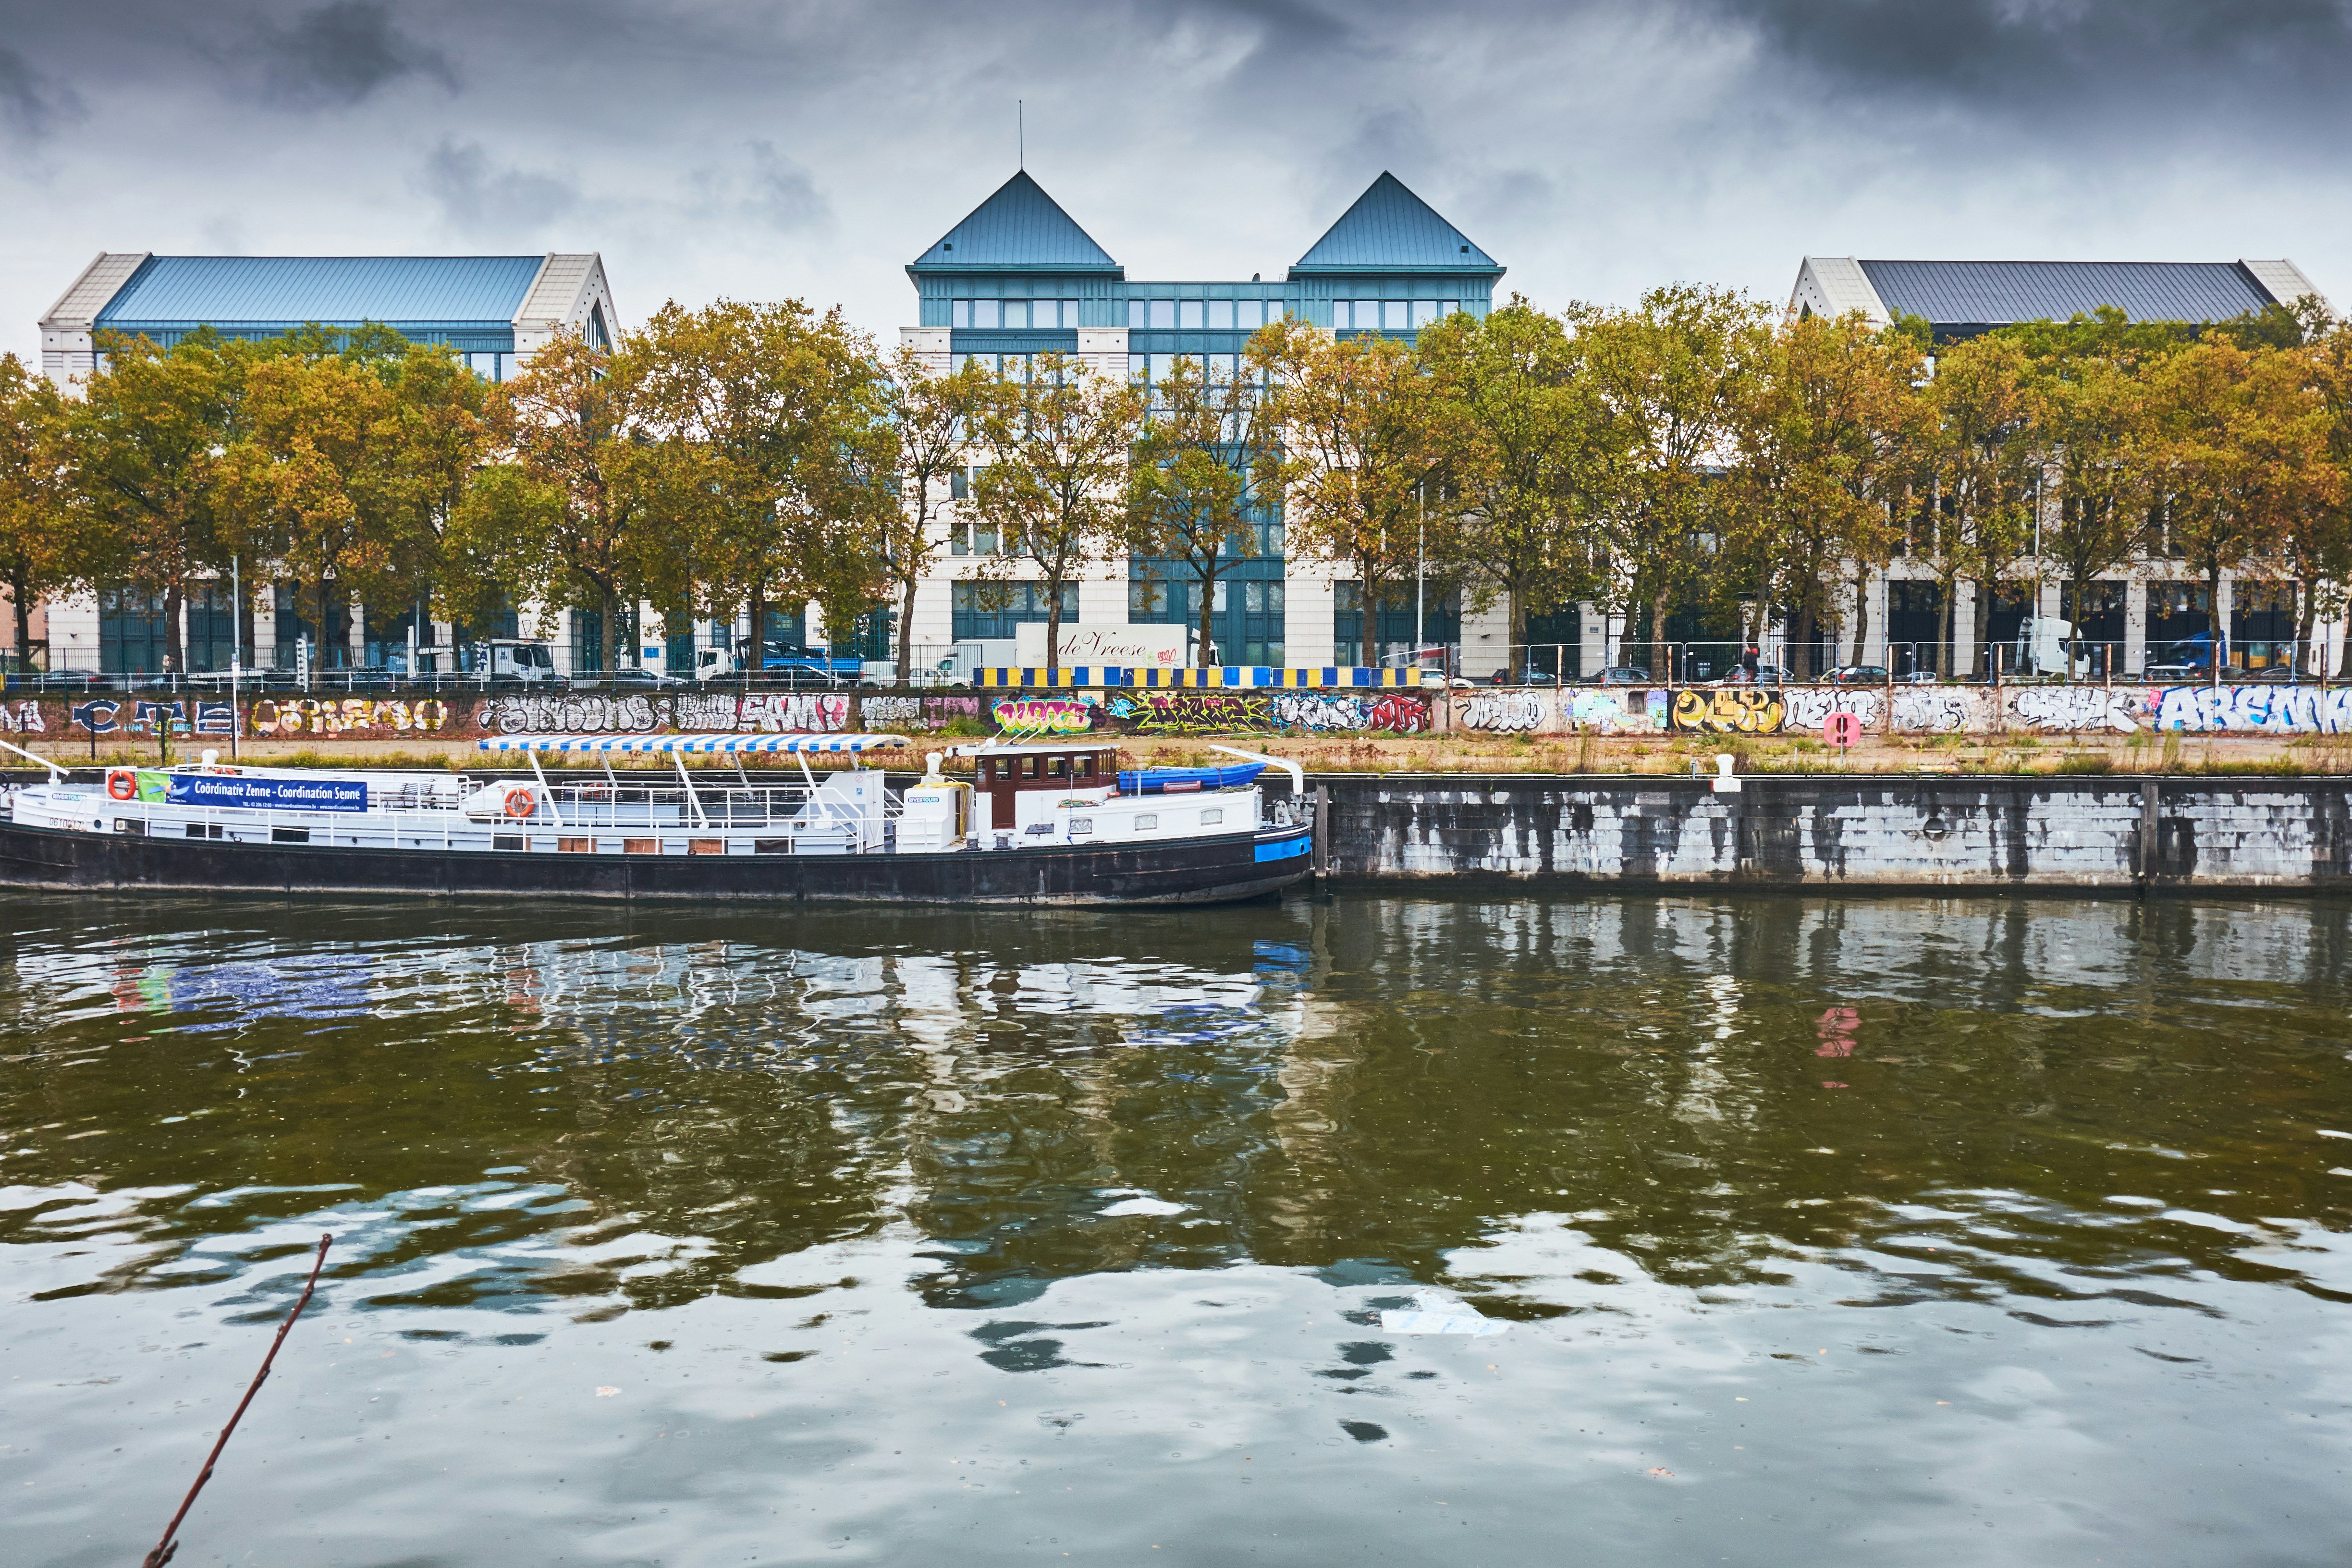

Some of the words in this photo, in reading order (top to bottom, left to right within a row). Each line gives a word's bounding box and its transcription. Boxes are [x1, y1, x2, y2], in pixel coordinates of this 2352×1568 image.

[1058, 634, 1081, 656] de
[1082, 631, 1146, 656] Vreese
[195, 781, 244, 796] Coördinatie
[246, 784, 270, 797] Zenne
[278, 784, 332, 799] Coordination
[335, 787, 360, 800] Senne
